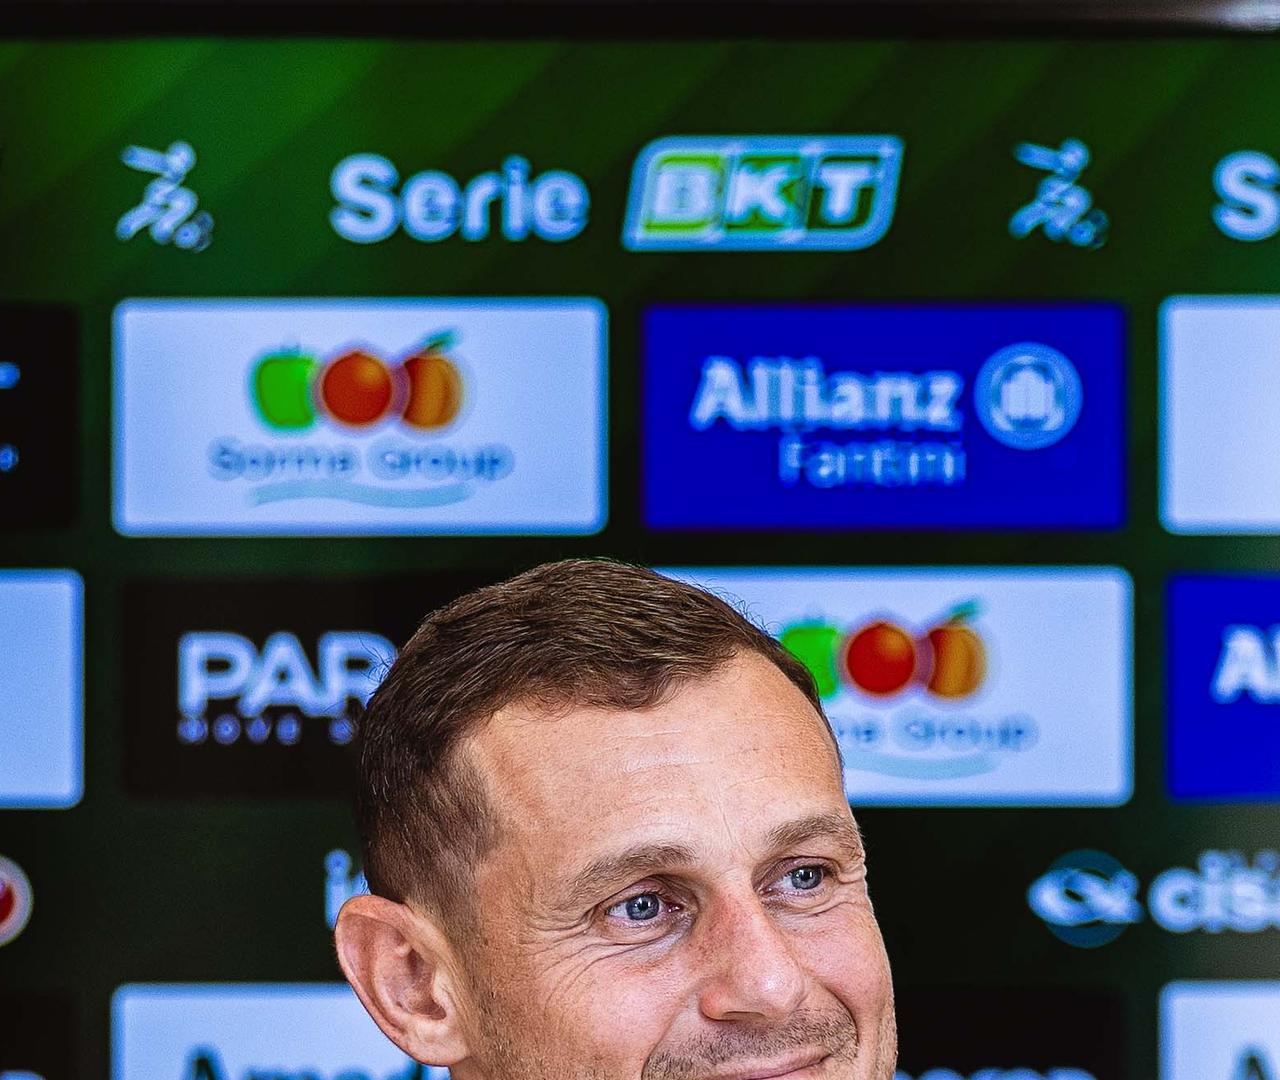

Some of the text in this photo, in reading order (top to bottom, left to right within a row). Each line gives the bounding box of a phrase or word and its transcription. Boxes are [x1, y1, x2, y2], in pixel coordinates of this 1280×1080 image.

[331, 154, 878, 242] Serie BKT
[692, 358, 960, 429] Allianz
